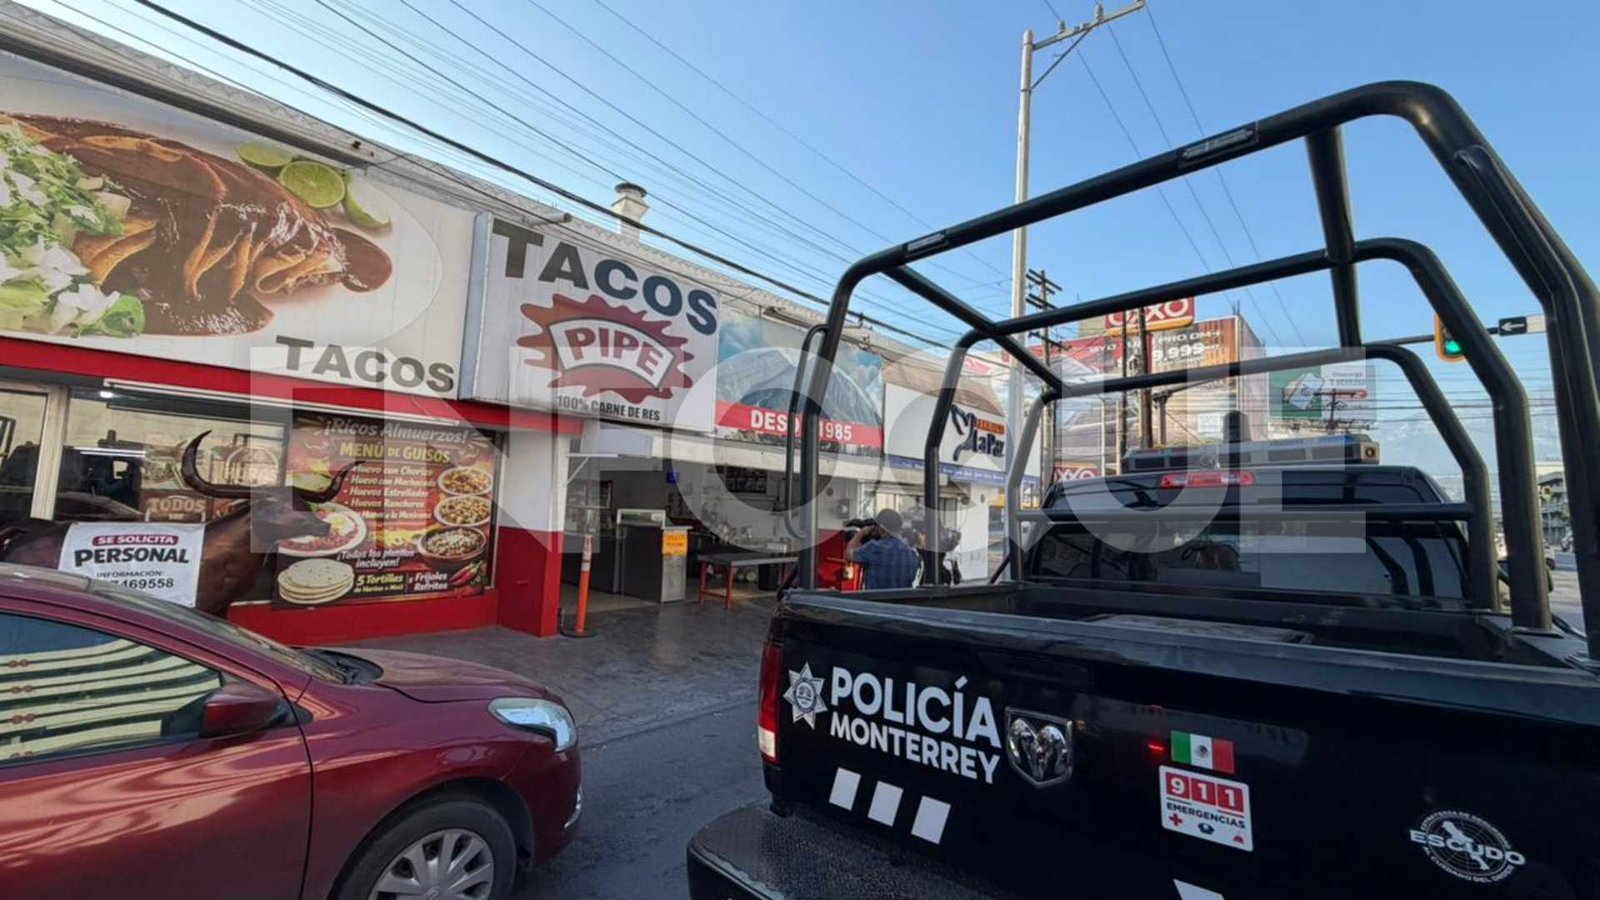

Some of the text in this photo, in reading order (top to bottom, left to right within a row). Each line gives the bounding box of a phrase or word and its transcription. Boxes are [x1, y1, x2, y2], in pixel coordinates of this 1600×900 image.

[493, 219, 718, 336] TACOS
[274, 335, 455, 393] TACOS
[563, 326, 664, 378] PIPE
[557, 394, 661, 421] 100% CARNE DE RES
[381, 422, 467, 444] Almuerzos!
[819, 420, 852, 441] 1985
[339, 441, 383, 458] MENÚ
[403, 446, 451, 463] GUISOS
[1054, 467, 1096, 484] XXO
[146, 497, 206, 513] TODOS
[98, 535, 175, 544] SE SOLICITA
[74, 547, 189, 567] PERSONAL
[357, 573, 404, 585] 5 Tortillas
[831, 666, 1002, 749] POLICÍA
[830, 711, 1000, 784] MONTERREY
[1166, 802, 1246, 830] EMERGENCIAS
[1409, 829, 1526, 866] ESCUDO
